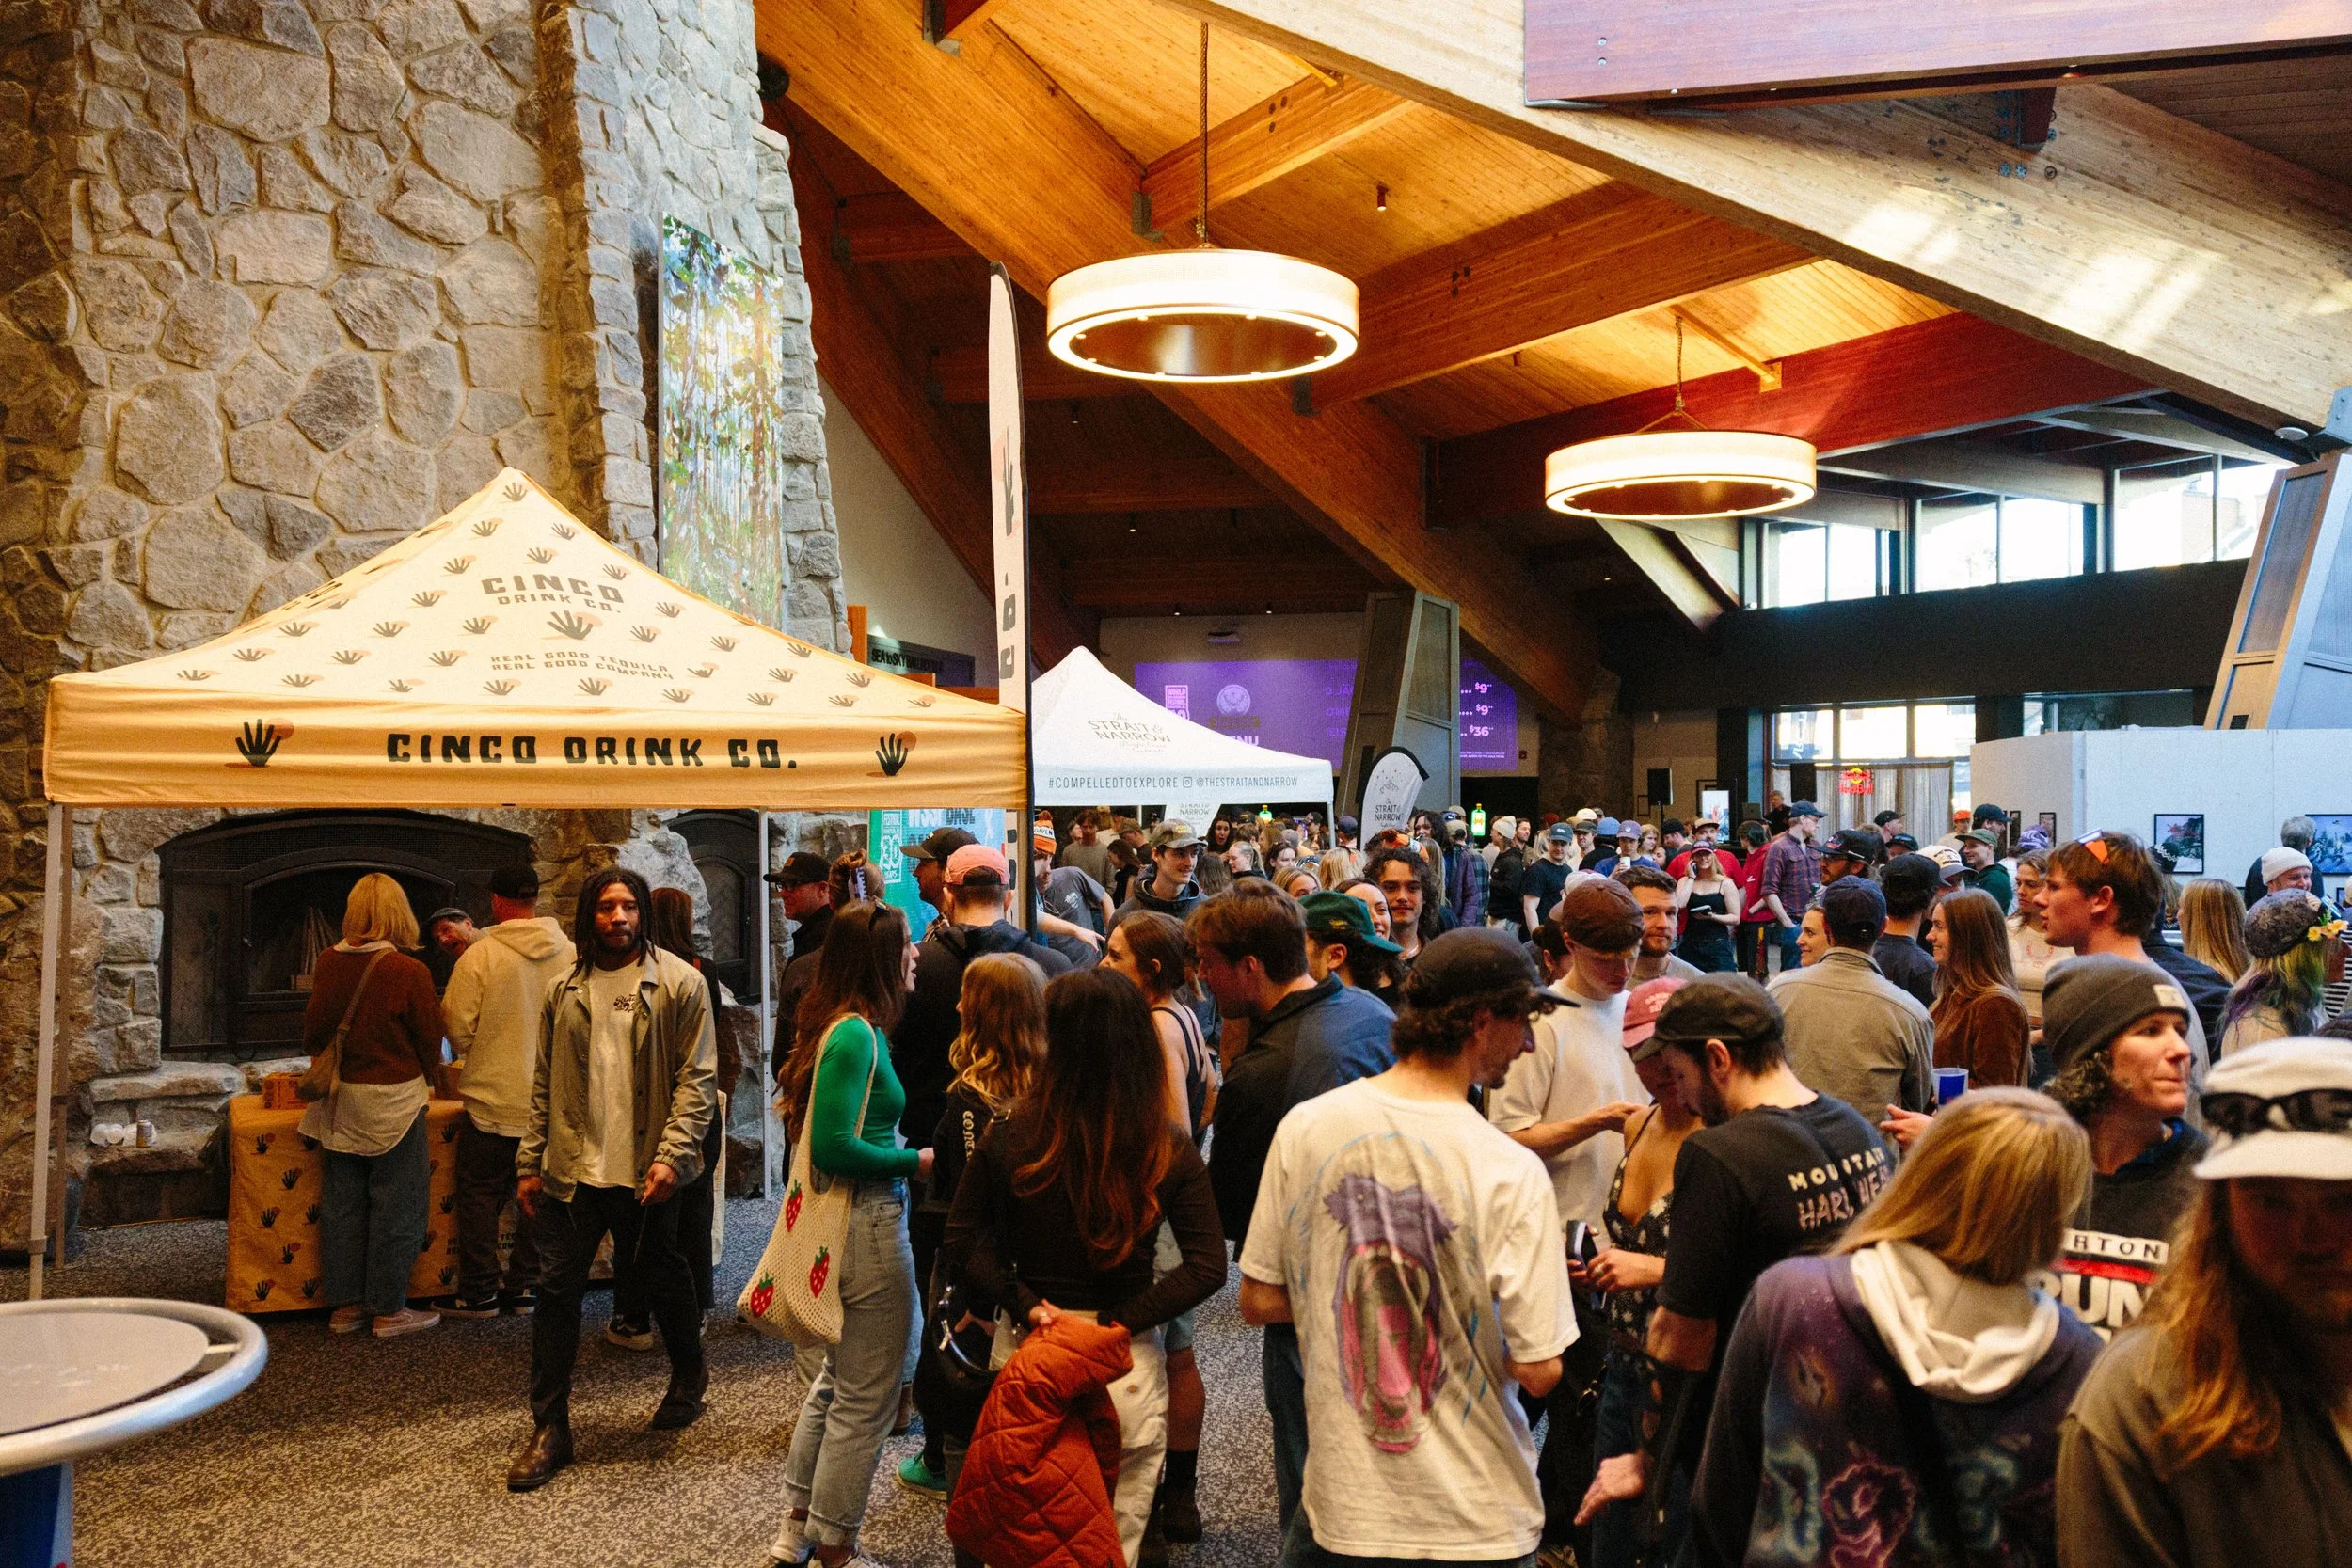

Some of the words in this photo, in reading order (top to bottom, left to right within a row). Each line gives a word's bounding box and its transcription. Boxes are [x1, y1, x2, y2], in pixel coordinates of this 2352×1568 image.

[481, 574, 624, 603] CINCO
[498, 593, 571, 605] DRINK
[584, 598, 621, 613] CO.
[491, 653, 536, 662] REAL
[545, 651, 590, 659] GOOD
[598, 656, 668, 672] TEQUILA
[492, 662, 535, 671] REAL
[545, 659, 588, 668] GOOD
[596, 663, 674, 679] COMPANY
[1088, 720, 1149, 733] STRAIT
[1095, 731, 1171, 742] NARROW
[387, 734, 537, 764] CINCO
[564, 736, 704, 767] DRINK
[728, 739, 797, 769] CO.
[1048, 776, 1178, 789] #COMPELLEDTOEXPLORE
[1196, 776, 1298, 788] @THESTRAITANDNARROW
[2073, 1234, 2161, 1259] RTON
